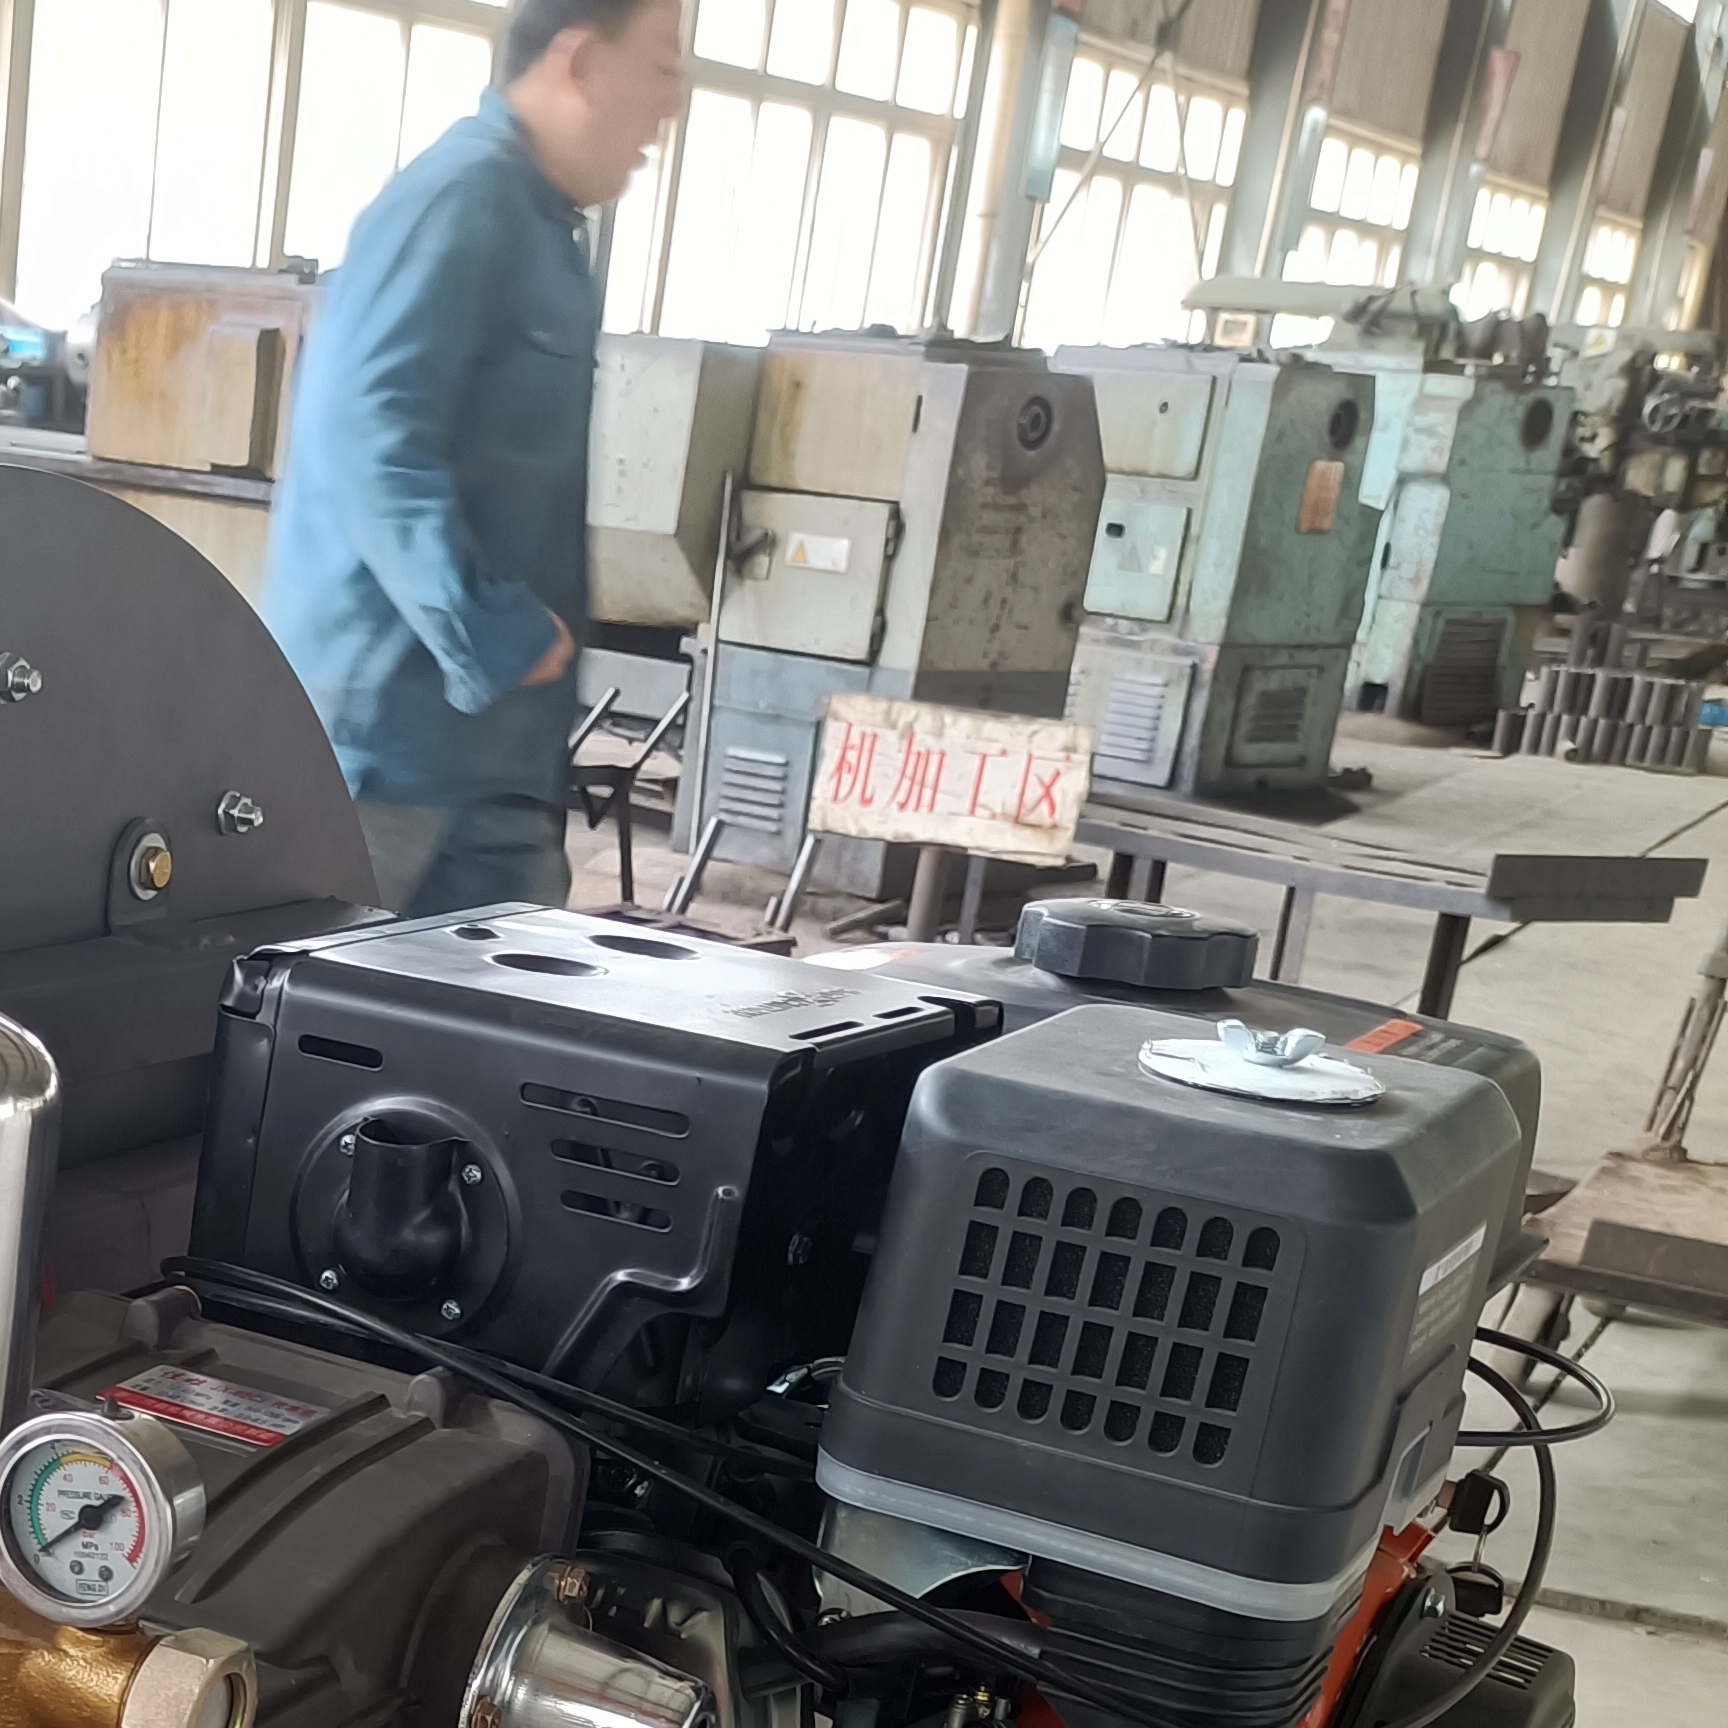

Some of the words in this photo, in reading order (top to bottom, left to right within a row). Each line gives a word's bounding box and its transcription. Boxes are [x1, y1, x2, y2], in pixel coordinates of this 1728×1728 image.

[829, 721, 1072, 829] 机加工区
[63, 1473, 73, 1483] 40
[46, 1502, 56, 1512] 20
[109, 1541, 125, 1552] 100
